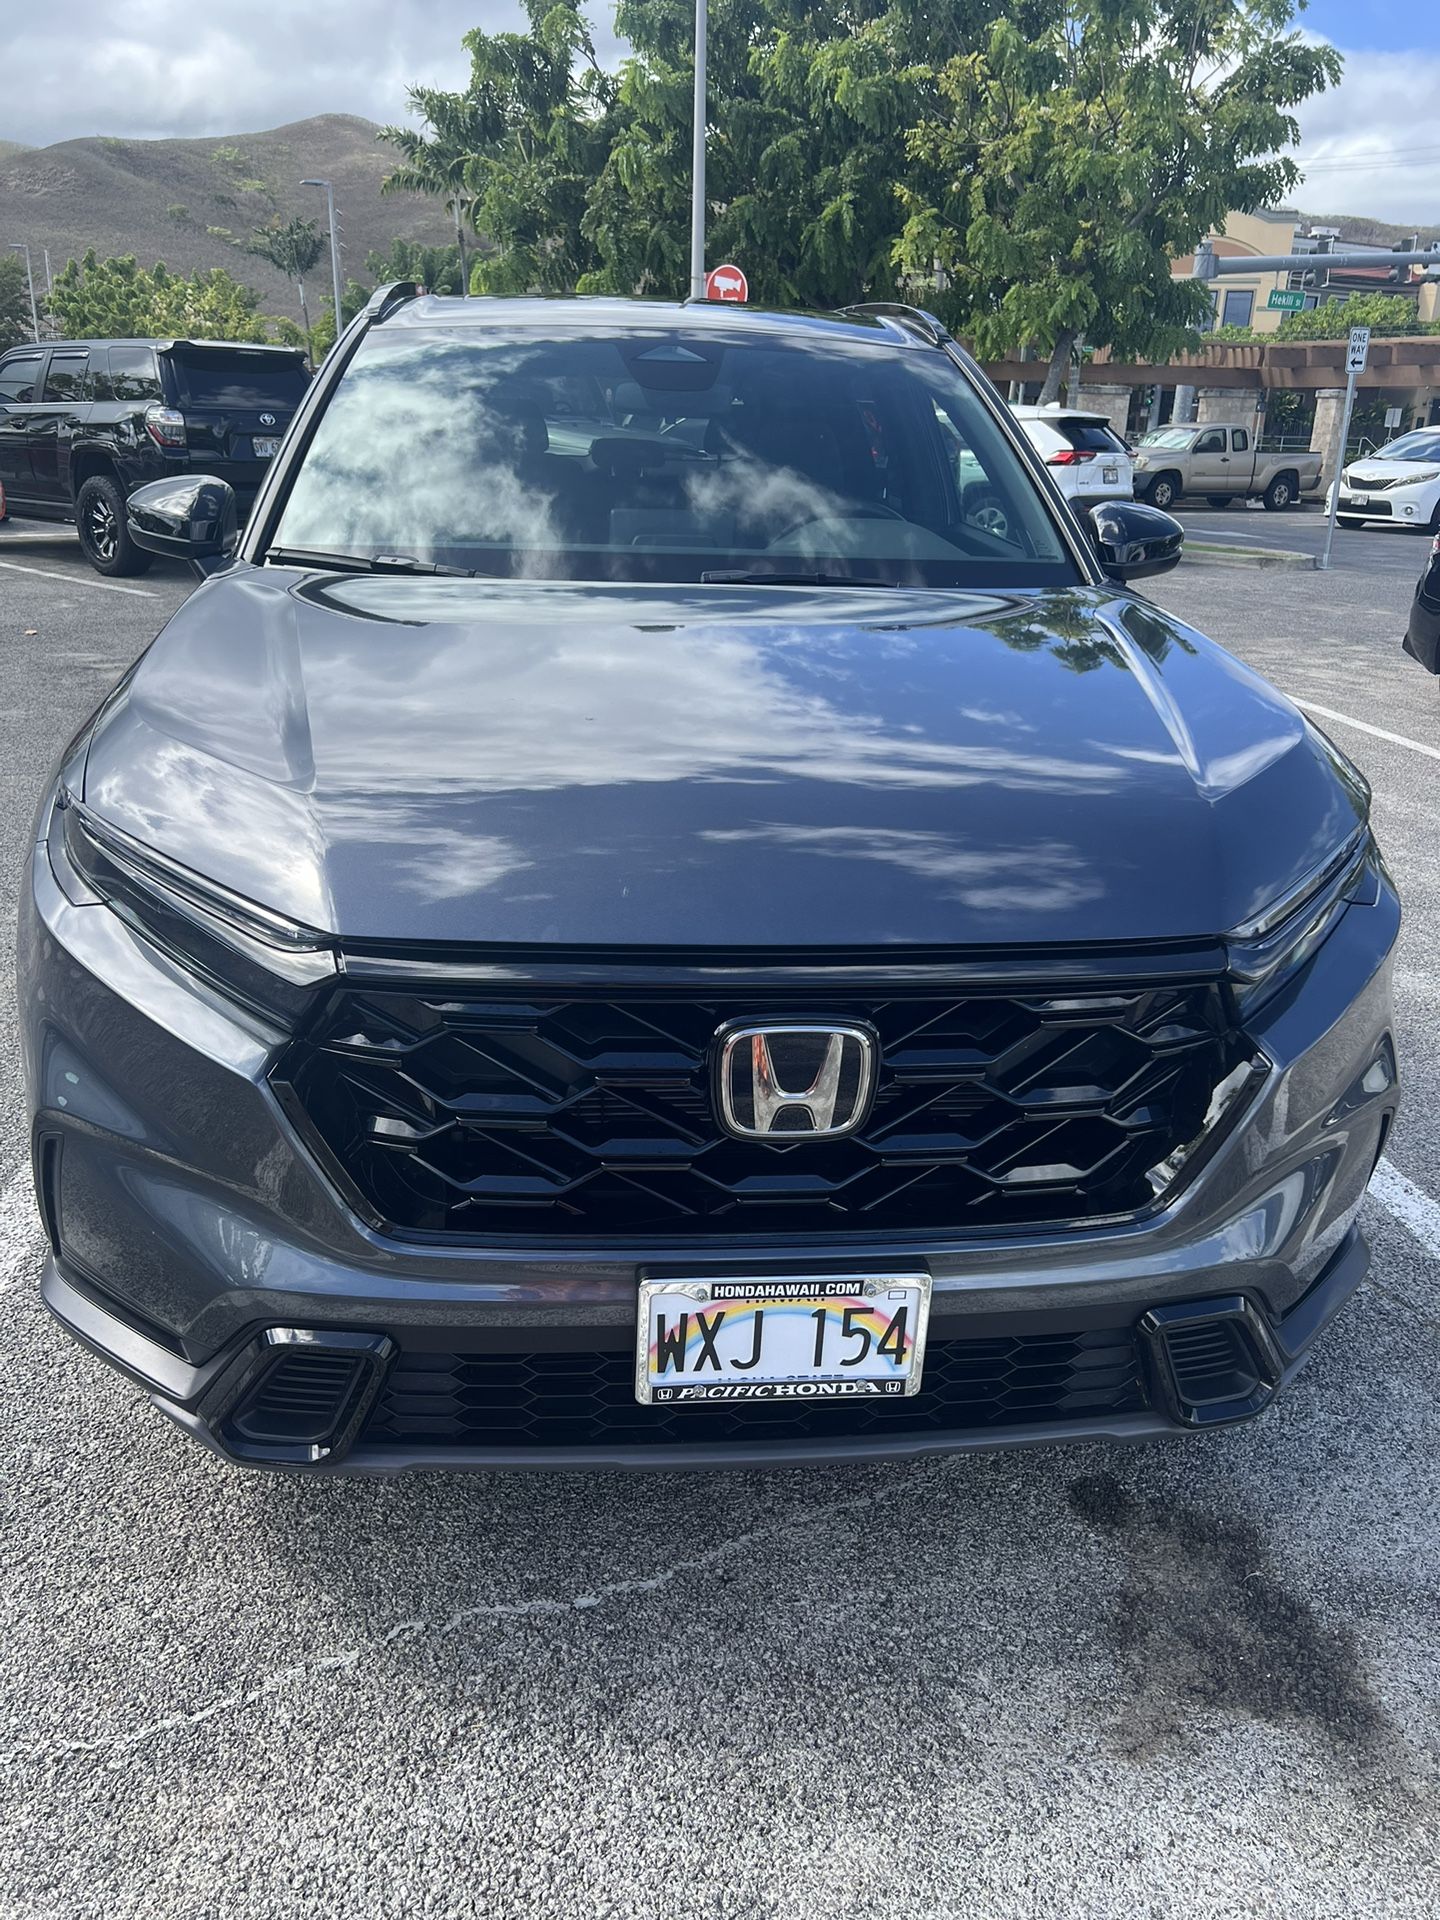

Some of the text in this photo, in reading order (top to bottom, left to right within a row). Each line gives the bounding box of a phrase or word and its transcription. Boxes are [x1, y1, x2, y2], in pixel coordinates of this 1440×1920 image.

[1271, 294, 1294, 306] Hekili
[1352, 332, 1367, 343] ONE
[1350, 345, 1365, 354] WAY
[714, 1283, 860, 1298] HONDAHAWAII.COM
[657, 1306, 908, 1373] WXJ 154
[774, 1382, 881, 1396] HONDA
